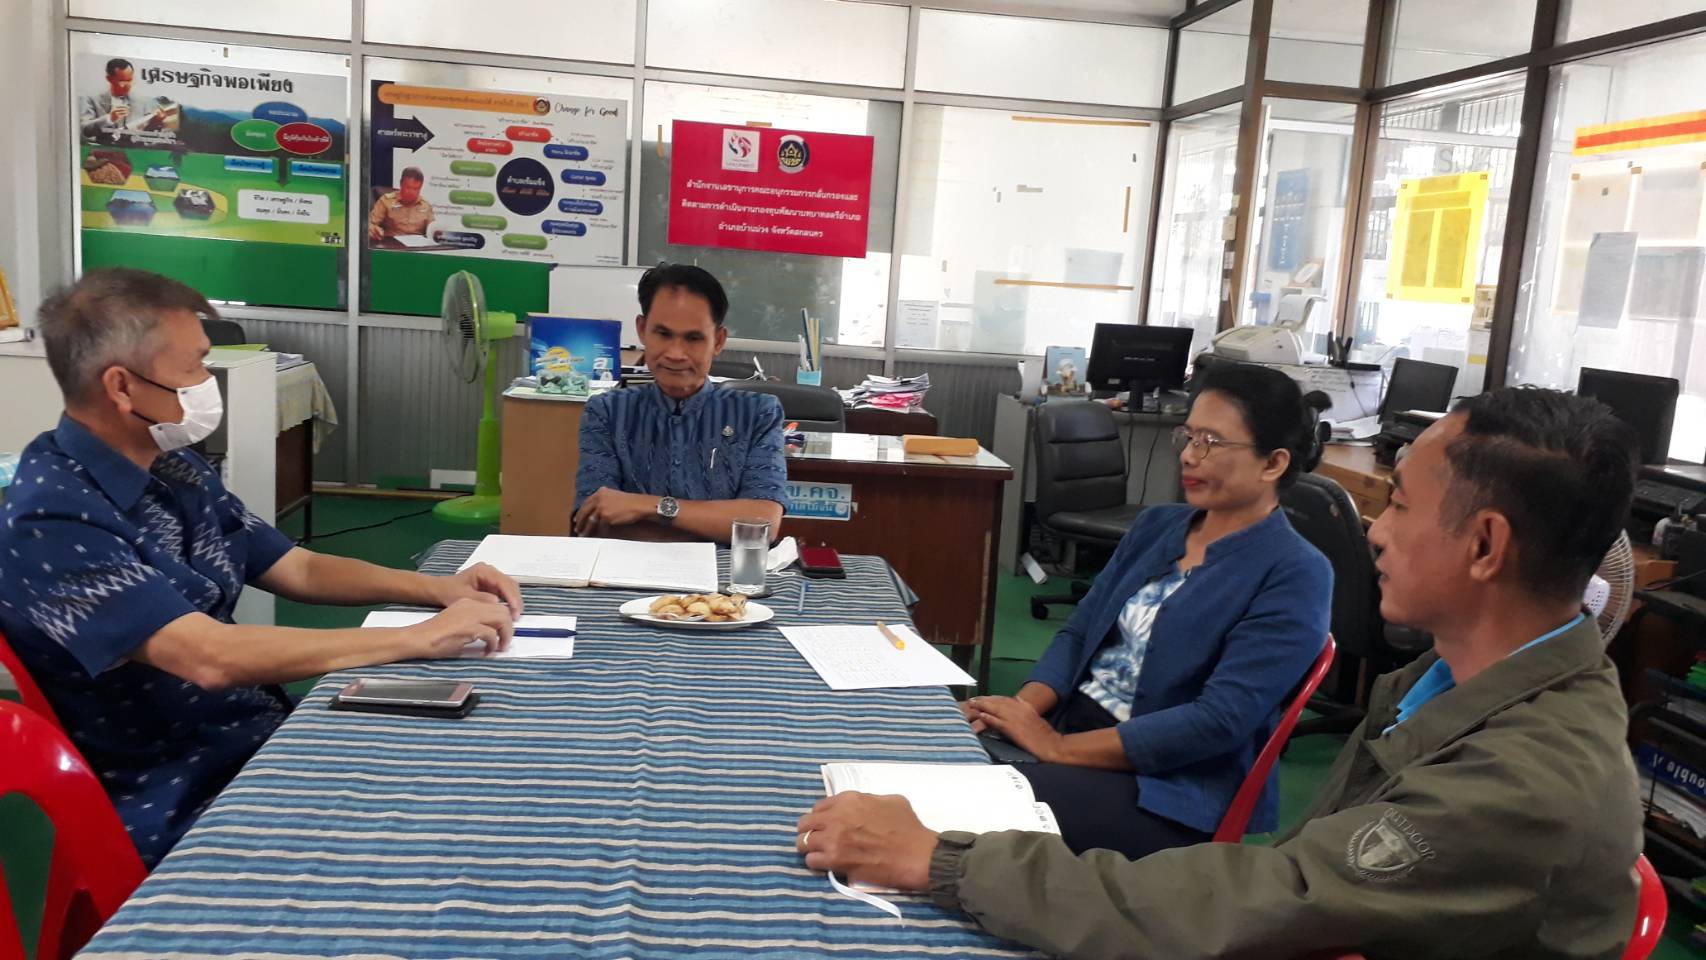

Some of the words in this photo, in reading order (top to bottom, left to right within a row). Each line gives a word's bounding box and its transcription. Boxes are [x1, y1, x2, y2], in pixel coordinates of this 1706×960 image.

[141, 67, 293, 93] เศรษฐกิจพอเพียง
[1667, 761, 1706, 793] ouble
